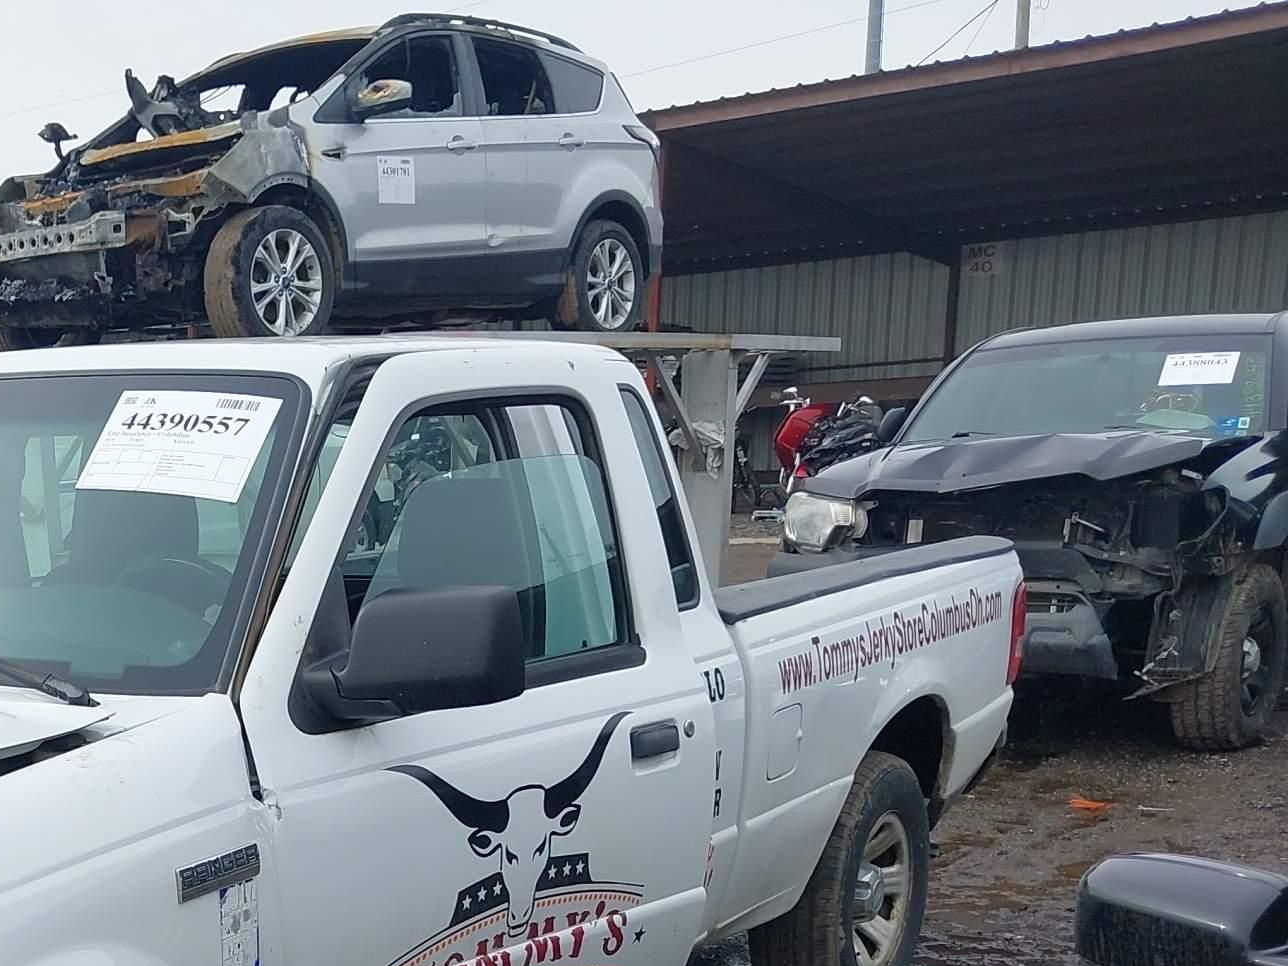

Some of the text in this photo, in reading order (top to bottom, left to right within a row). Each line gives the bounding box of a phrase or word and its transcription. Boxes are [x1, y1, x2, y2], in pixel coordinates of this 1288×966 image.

[968, 245, 996, 259] MC
[968, 260, 993, 273] 40
[121, 412, 251, 436] 44390557
[777, 587, 1002, 695] www.TommysJerkyStoreColumbusOh.com
[182, 848, 260, 890] RANGER
